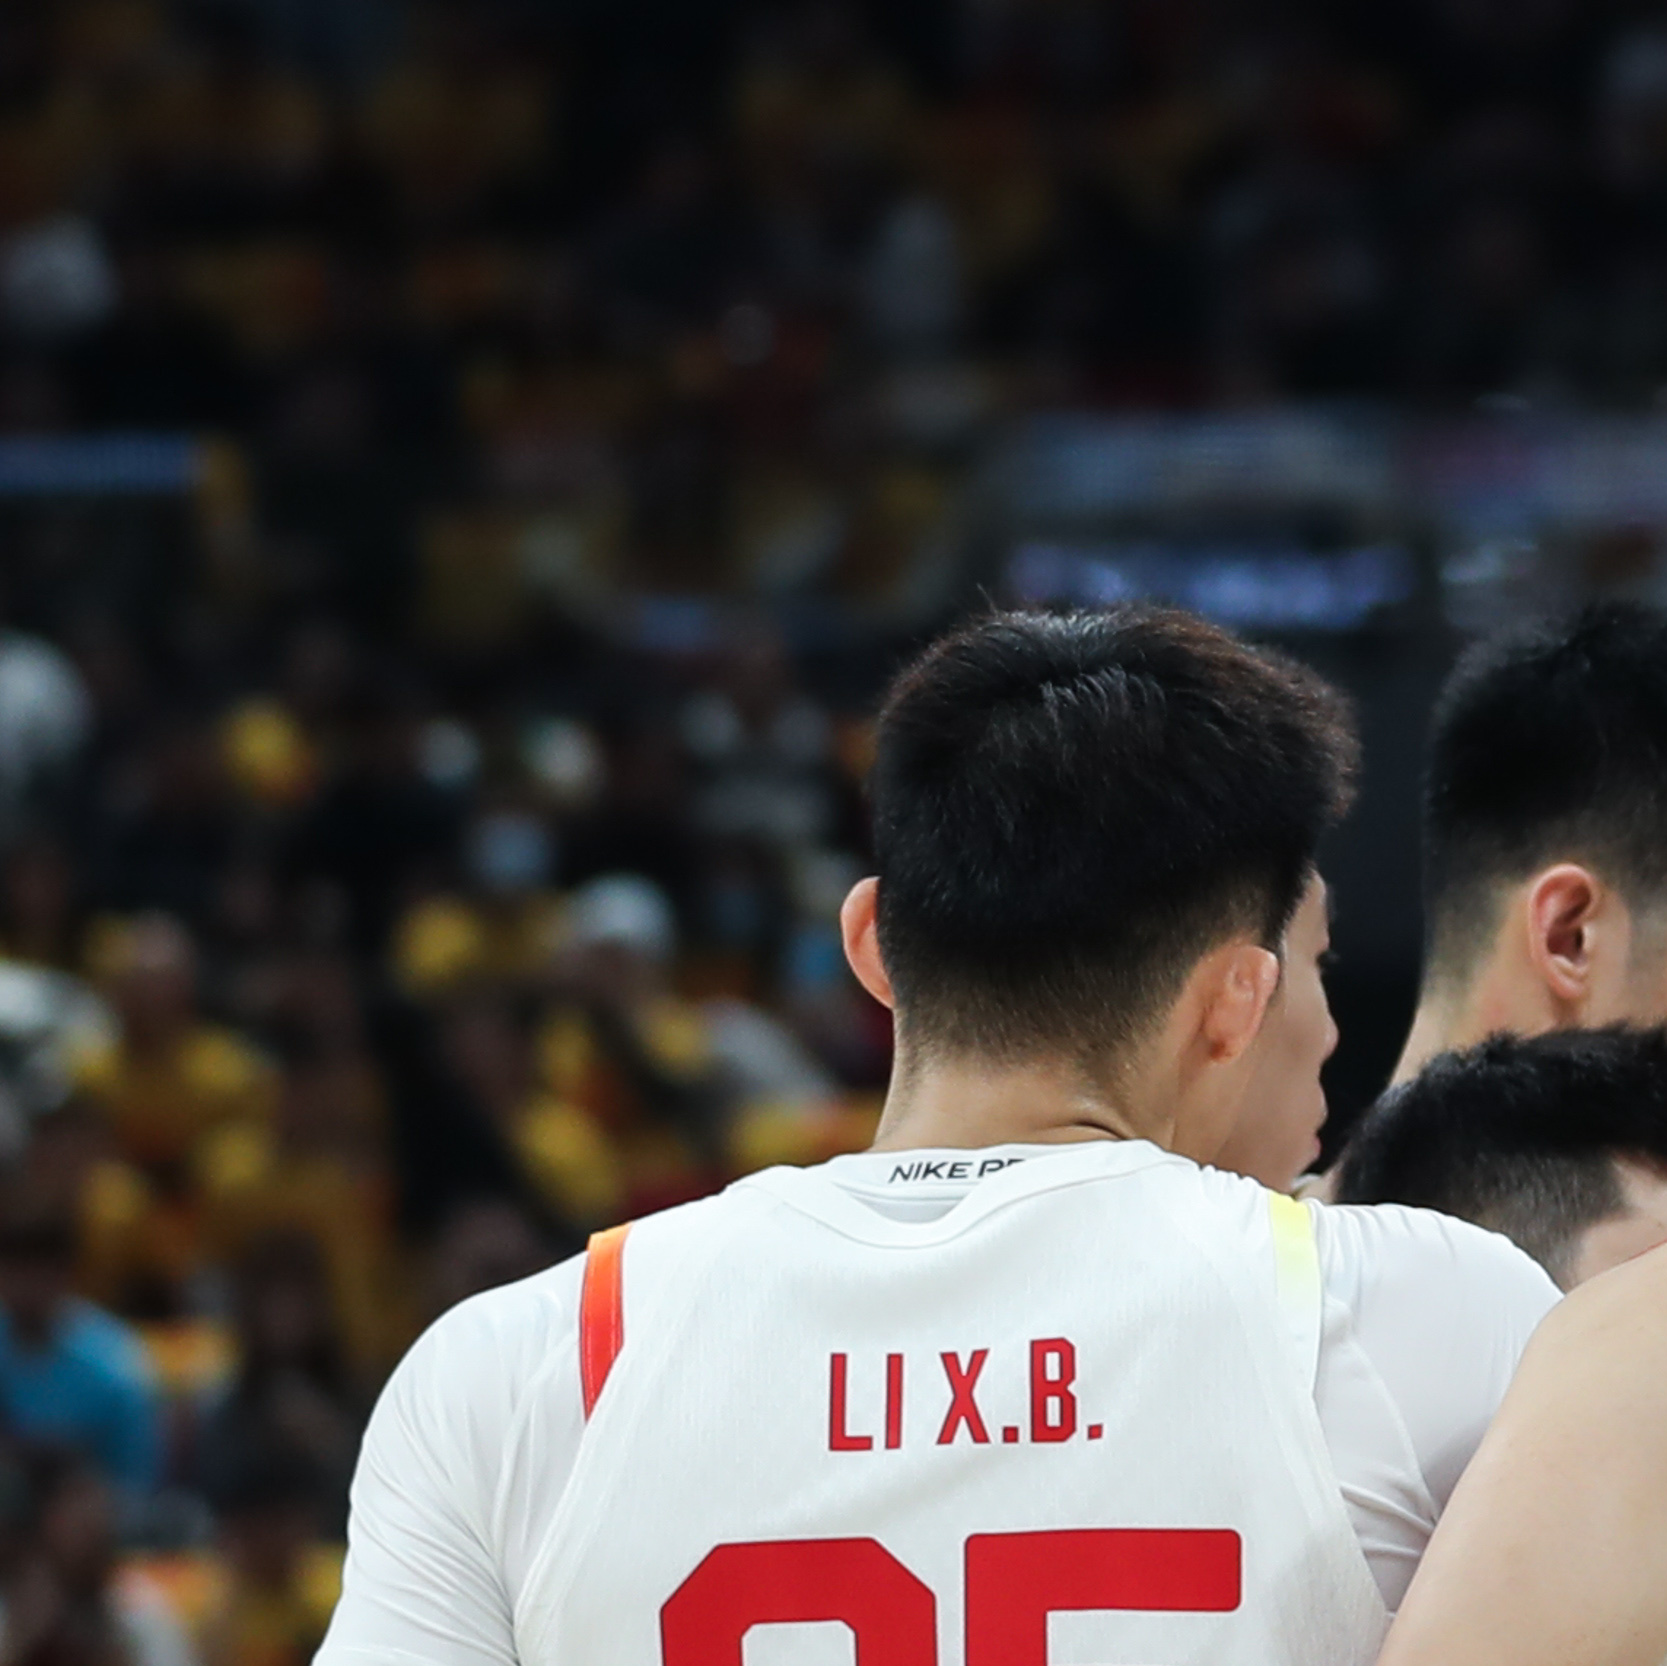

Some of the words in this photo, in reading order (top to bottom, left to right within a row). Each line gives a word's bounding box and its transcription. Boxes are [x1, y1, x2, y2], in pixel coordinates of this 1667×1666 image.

[888, 1161, 973, 1184] NIKE
[977, 1158, 1027, 1178] P
[828, 1352, 904, 1452] LI
[936, 1336, 1104, 1446] X.B.
